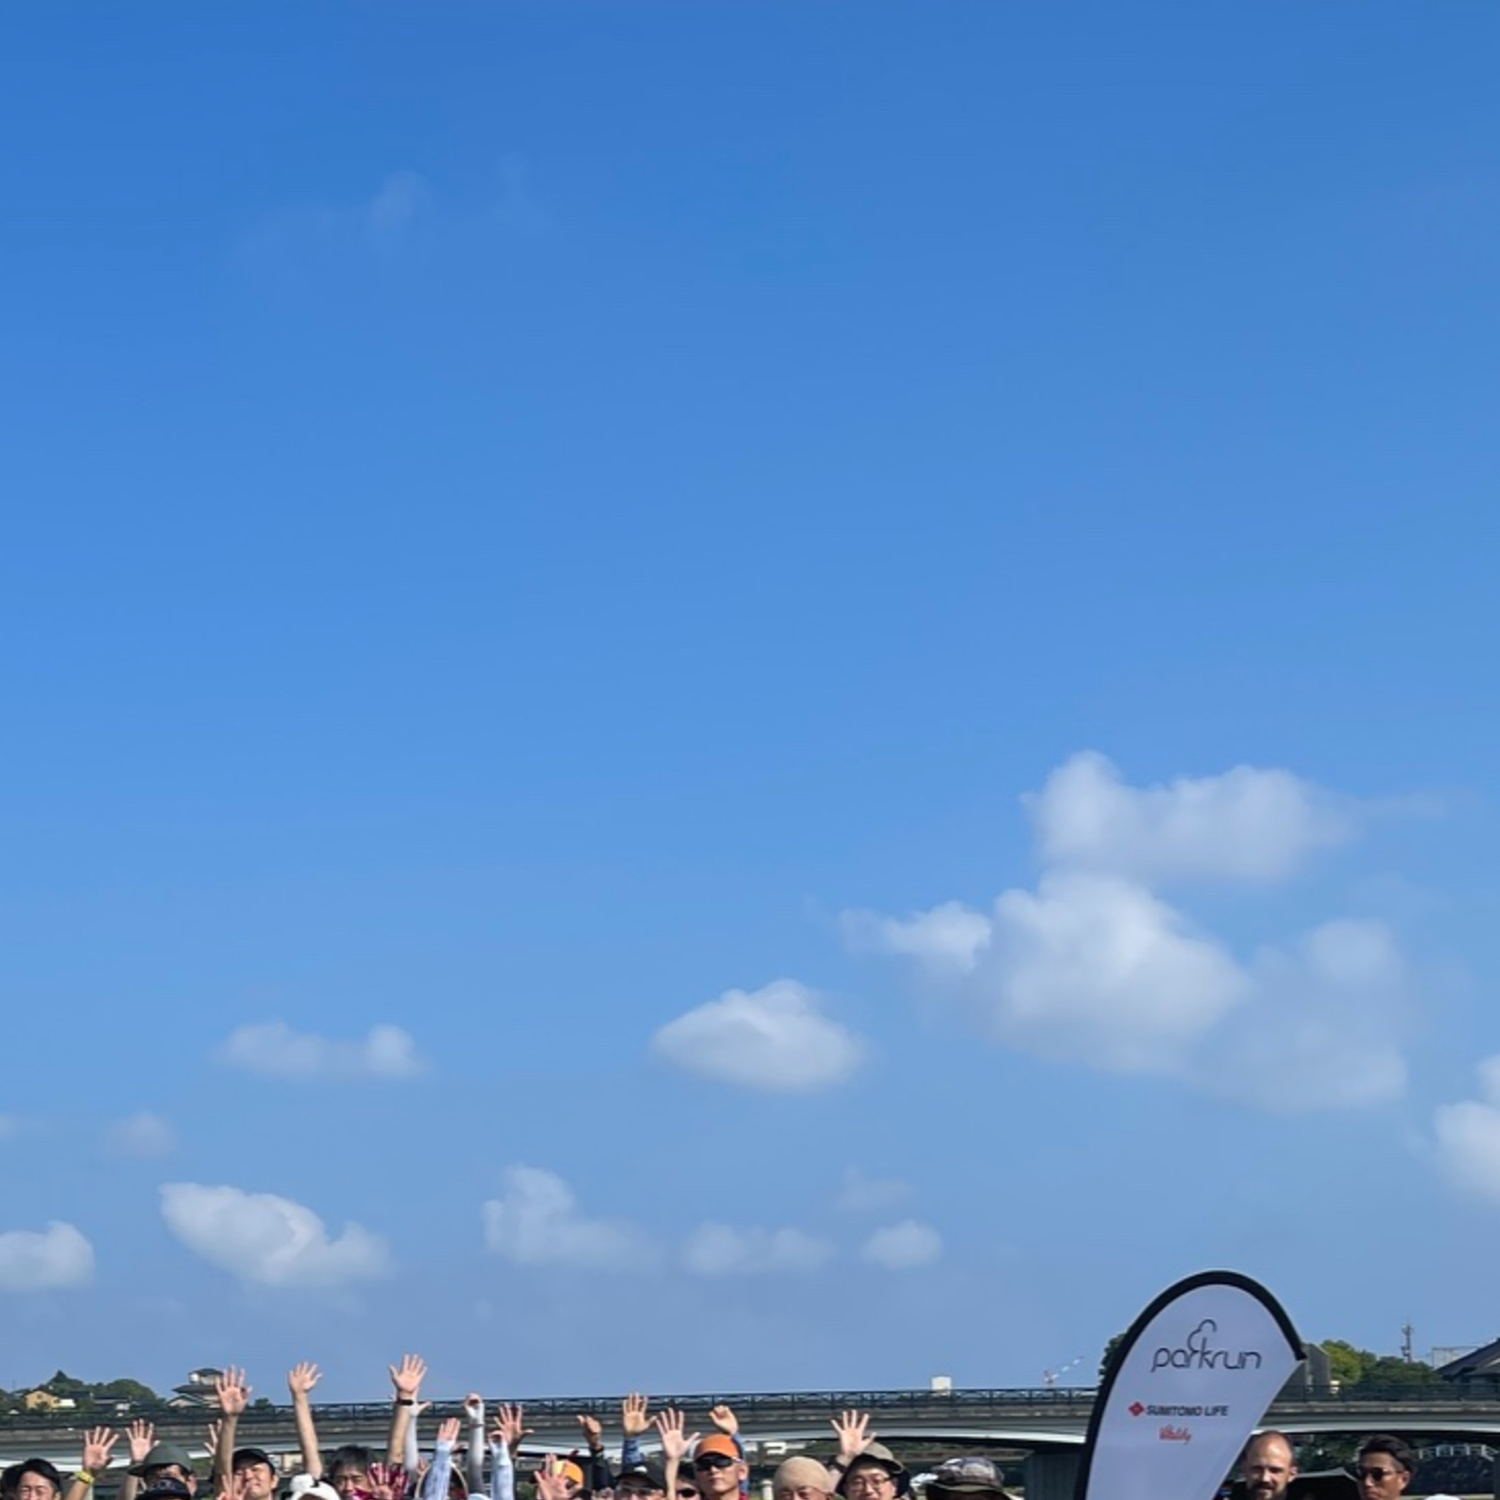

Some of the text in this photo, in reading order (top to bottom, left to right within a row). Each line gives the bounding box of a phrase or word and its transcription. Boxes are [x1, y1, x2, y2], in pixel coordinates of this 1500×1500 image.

[1151, 1336, 1262, 1374] parkrun
[1147, 1405, 1229, 1417] SUMITOMO LIFE
